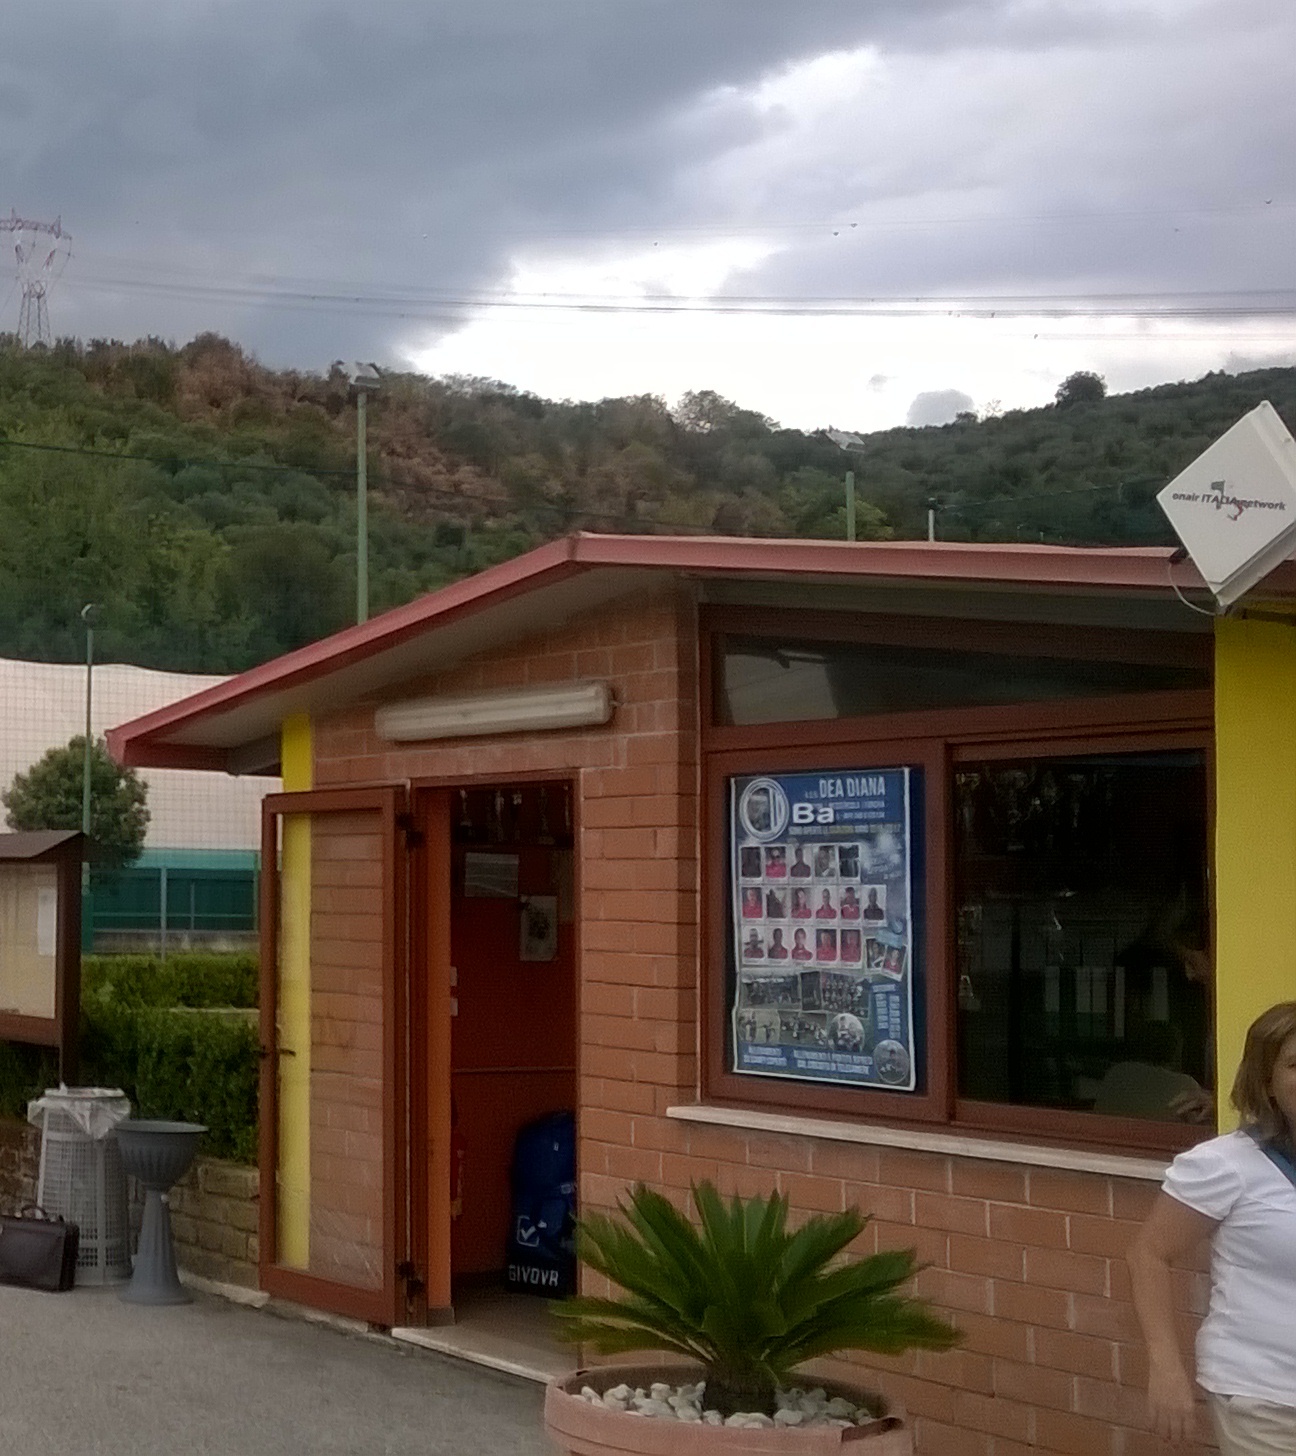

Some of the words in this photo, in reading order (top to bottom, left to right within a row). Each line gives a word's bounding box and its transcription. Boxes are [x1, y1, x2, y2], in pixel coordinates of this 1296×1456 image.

[1172, 493, 1200, 502] onair
[819, 777, 844, 798] DEA
[846, 776, 886, 797] DIANA
[792, 802, 834, 824] Ba
